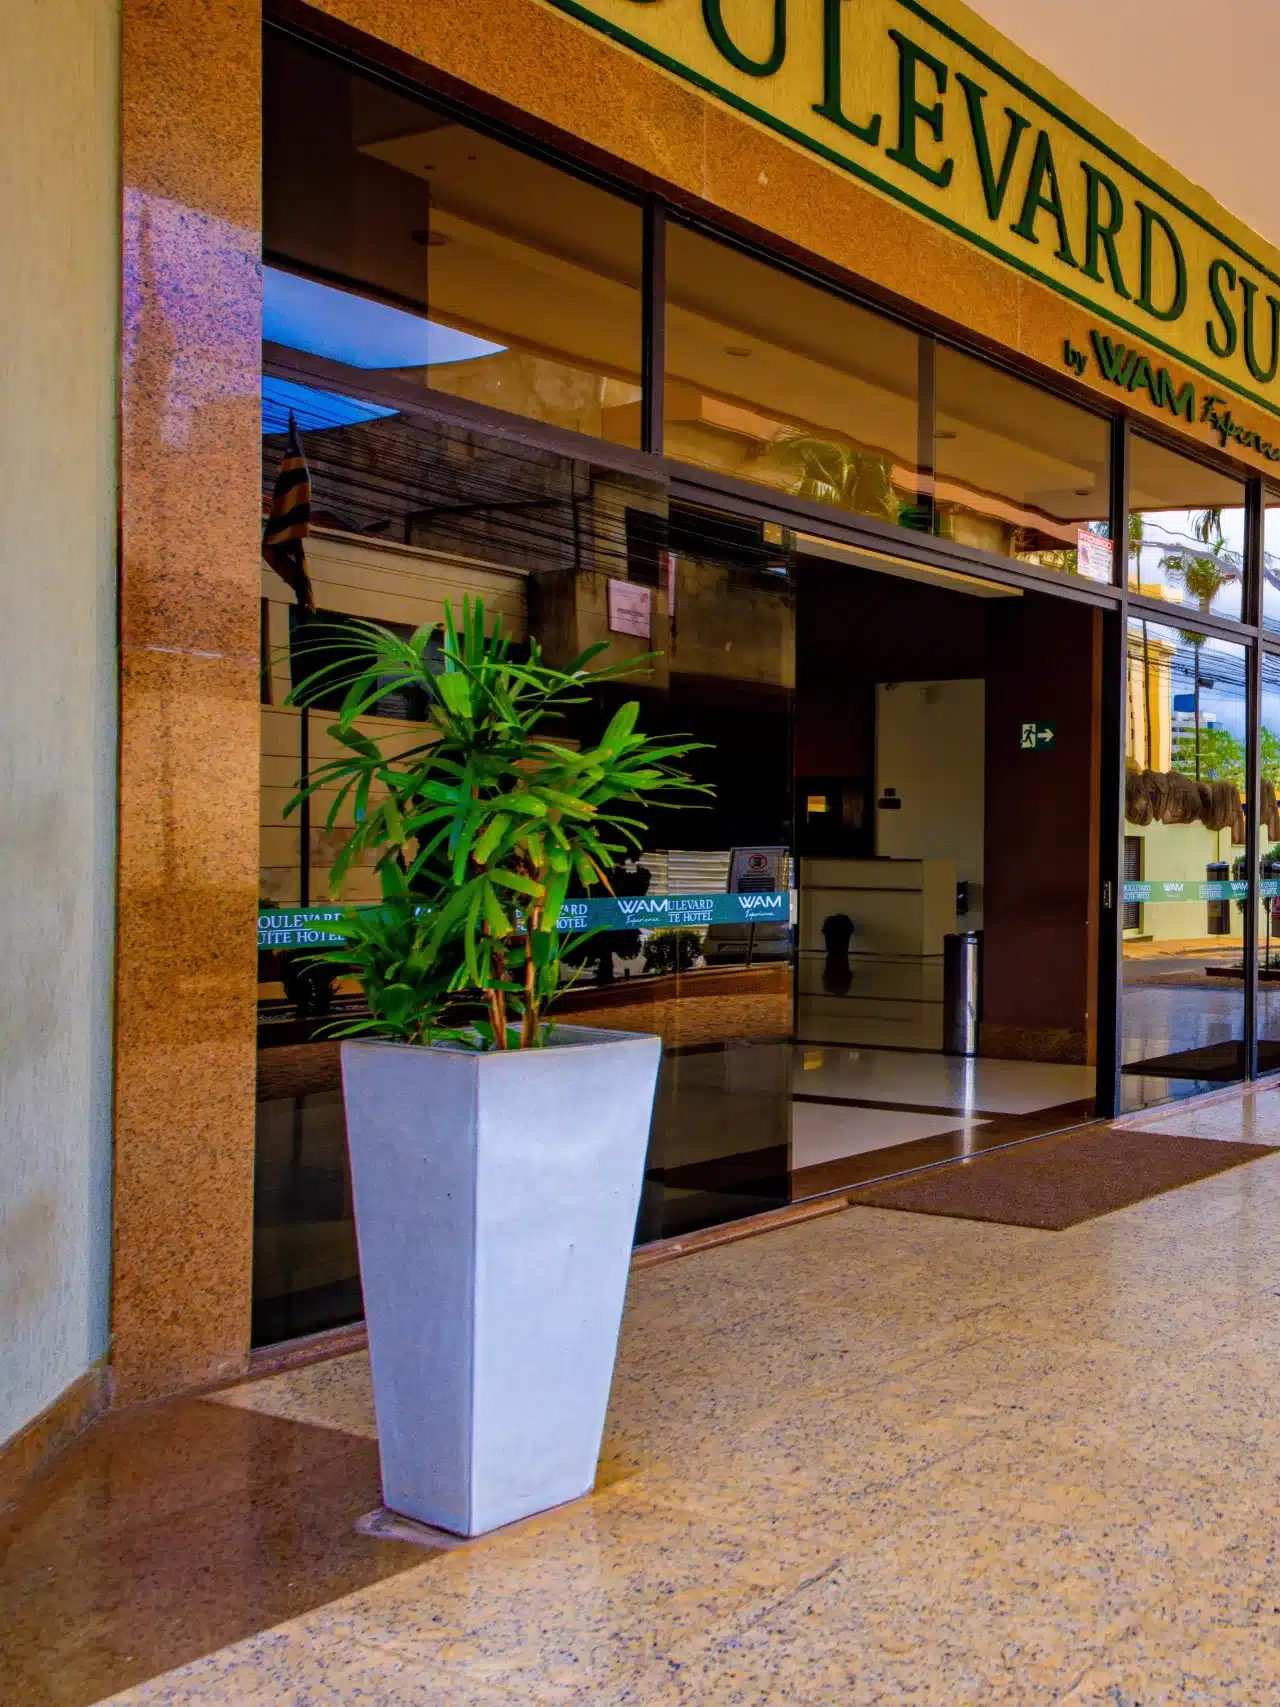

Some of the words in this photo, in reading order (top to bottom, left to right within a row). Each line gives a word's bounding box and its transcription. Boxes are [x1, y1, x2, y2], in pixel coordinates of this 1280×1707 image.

[1064, 338, 1088, 376] by
[1089, 329, 1196, 423] WAM
[616, 898, 669, 914] WAM
[738, 894, 782, 909] WAM
[683, 912, 713, 922] HOTEL
